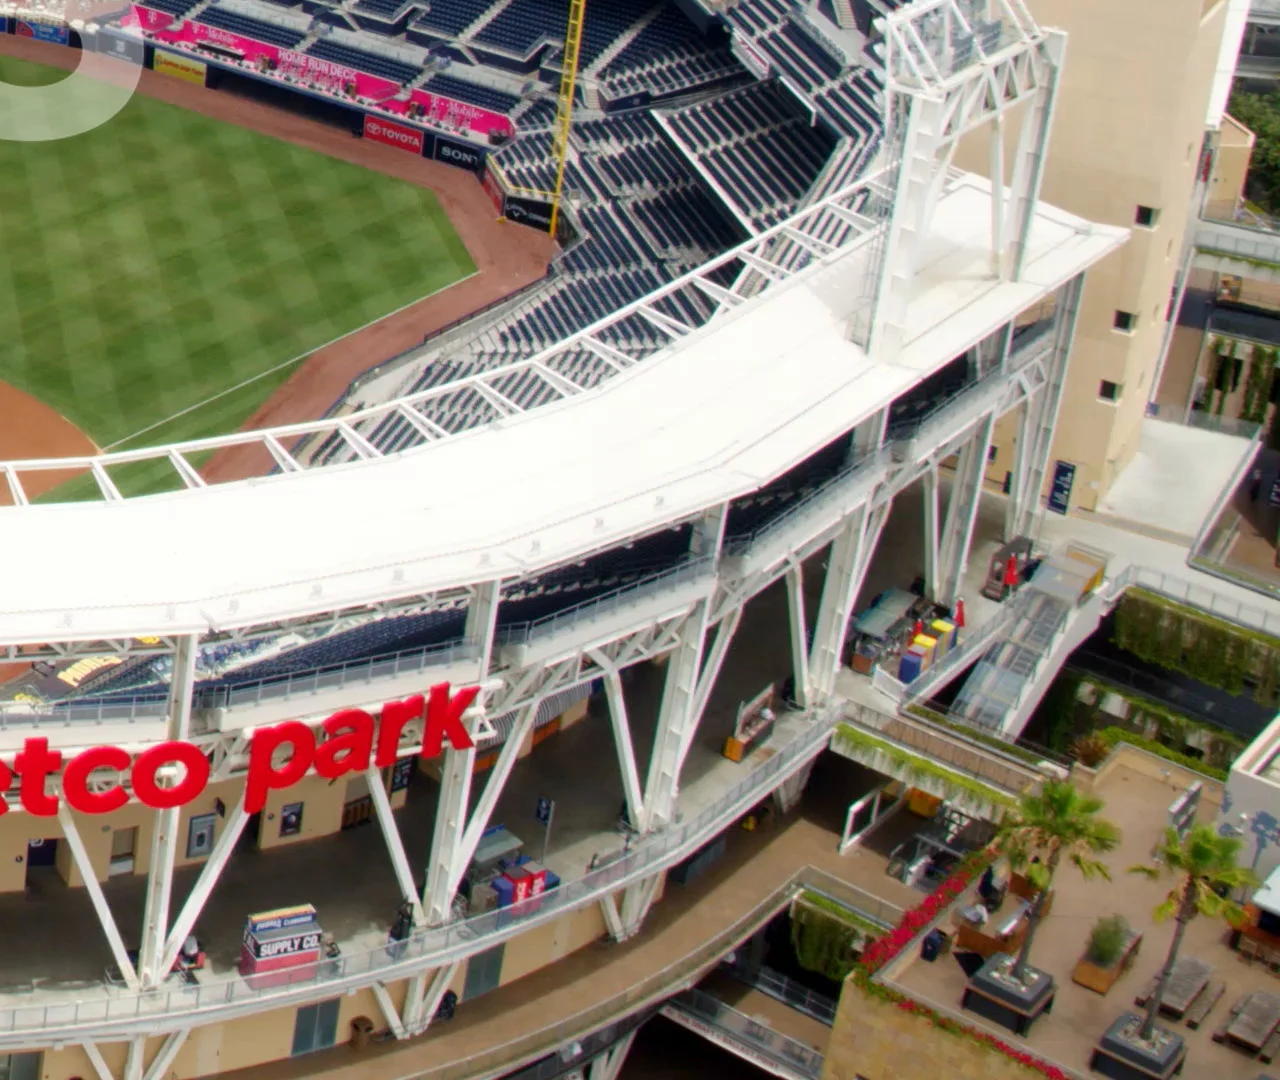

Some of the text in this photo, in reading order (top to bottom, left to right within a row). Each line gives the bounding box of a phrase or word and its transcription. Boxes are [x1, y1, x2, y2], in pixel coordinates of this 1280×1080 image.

[278, 49, 358, 81] HOME RUN DECK
[381, 127, 420, 147] TOYOTA
[243, 680, 483, 814] park
[260, 935, 321, 957] SUPPLY CO.
